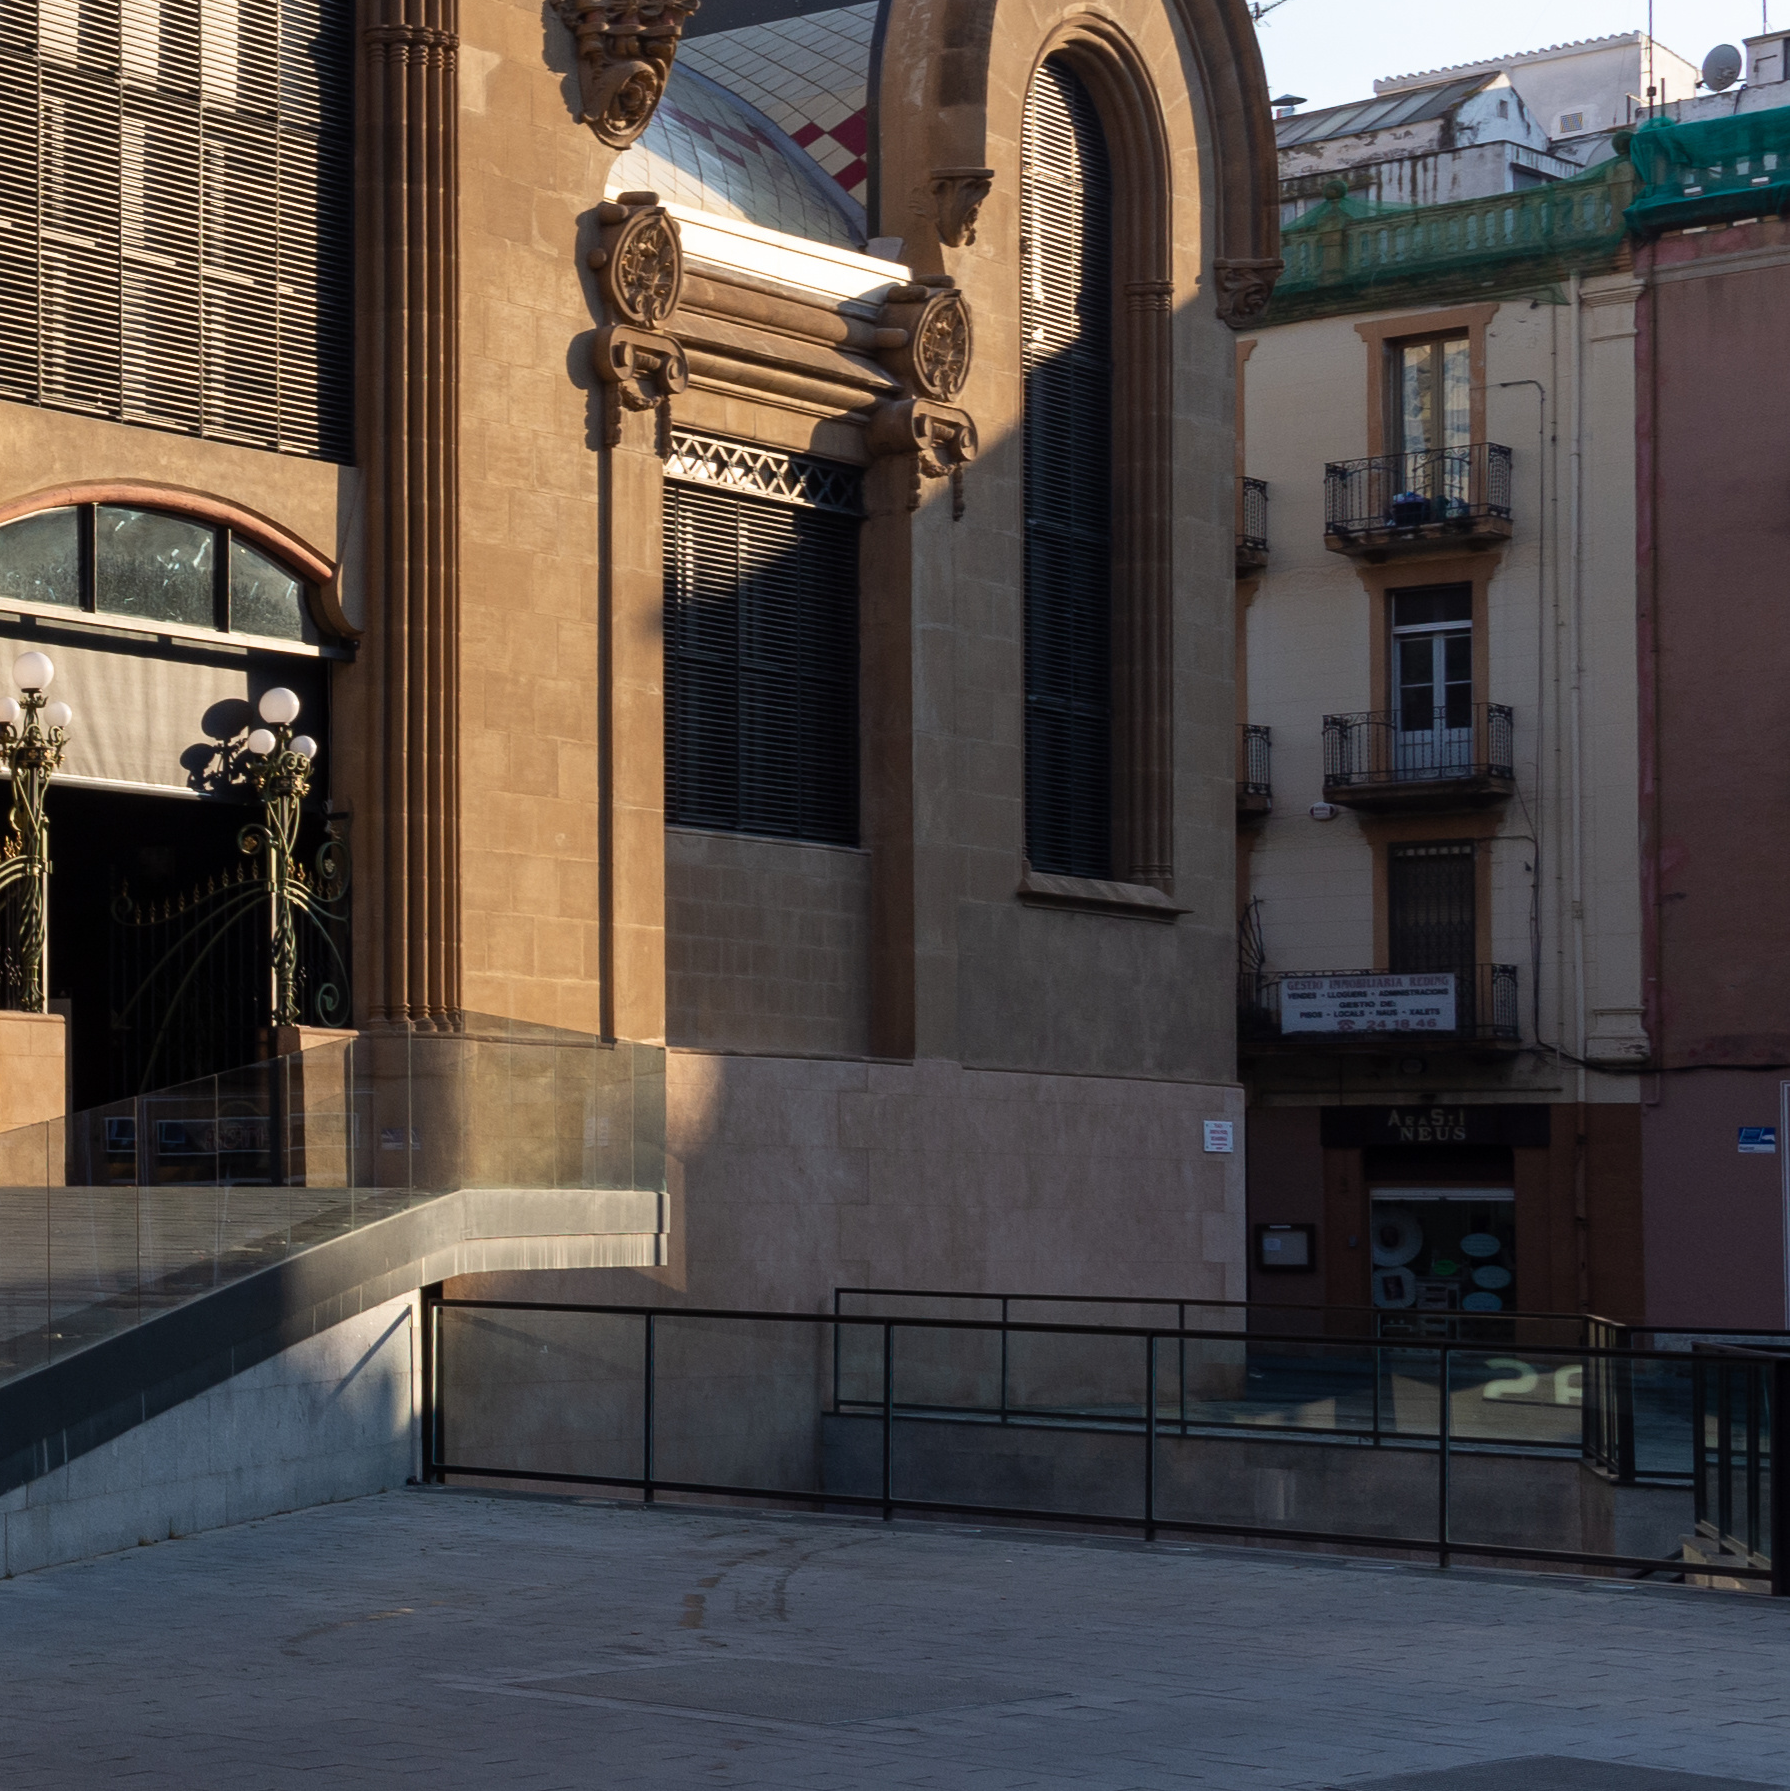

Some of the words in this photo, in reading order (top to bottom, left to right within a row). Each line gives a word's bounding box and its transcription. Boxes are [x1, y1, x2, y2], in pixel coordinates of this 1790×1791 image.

[1329, 978, 1403, 989] IMMOBILIARIA
[1409, 976, 1449, 986] REDING
[1366, 1020, 1386, 1029] 24
[1392, 1019, 1410, 1028] 18
[1416, 1018, 1437, 1027] 46
[1399, 1127, 1466, 1141] NEUS
